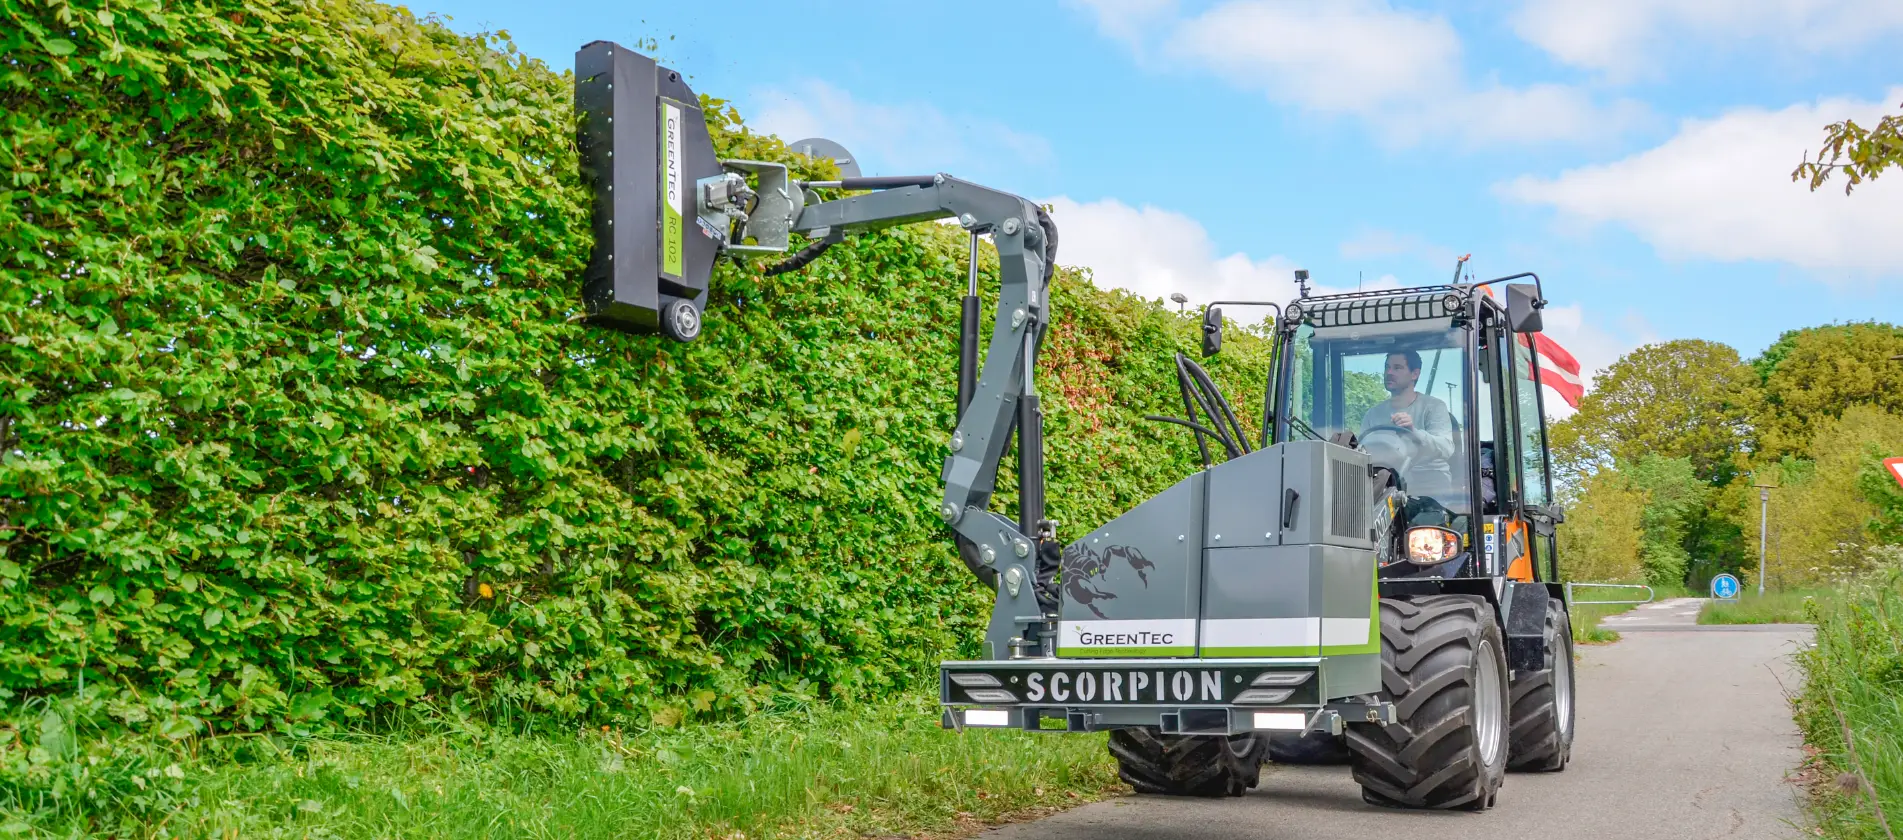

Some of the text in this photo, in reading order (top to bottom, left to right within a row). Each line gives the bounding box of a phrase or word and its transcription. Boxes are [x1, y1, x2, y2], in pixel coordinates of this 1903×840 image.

[668, 216, 677, 264] RC 102
[1026, 670, 1222, 702] SCORPION
